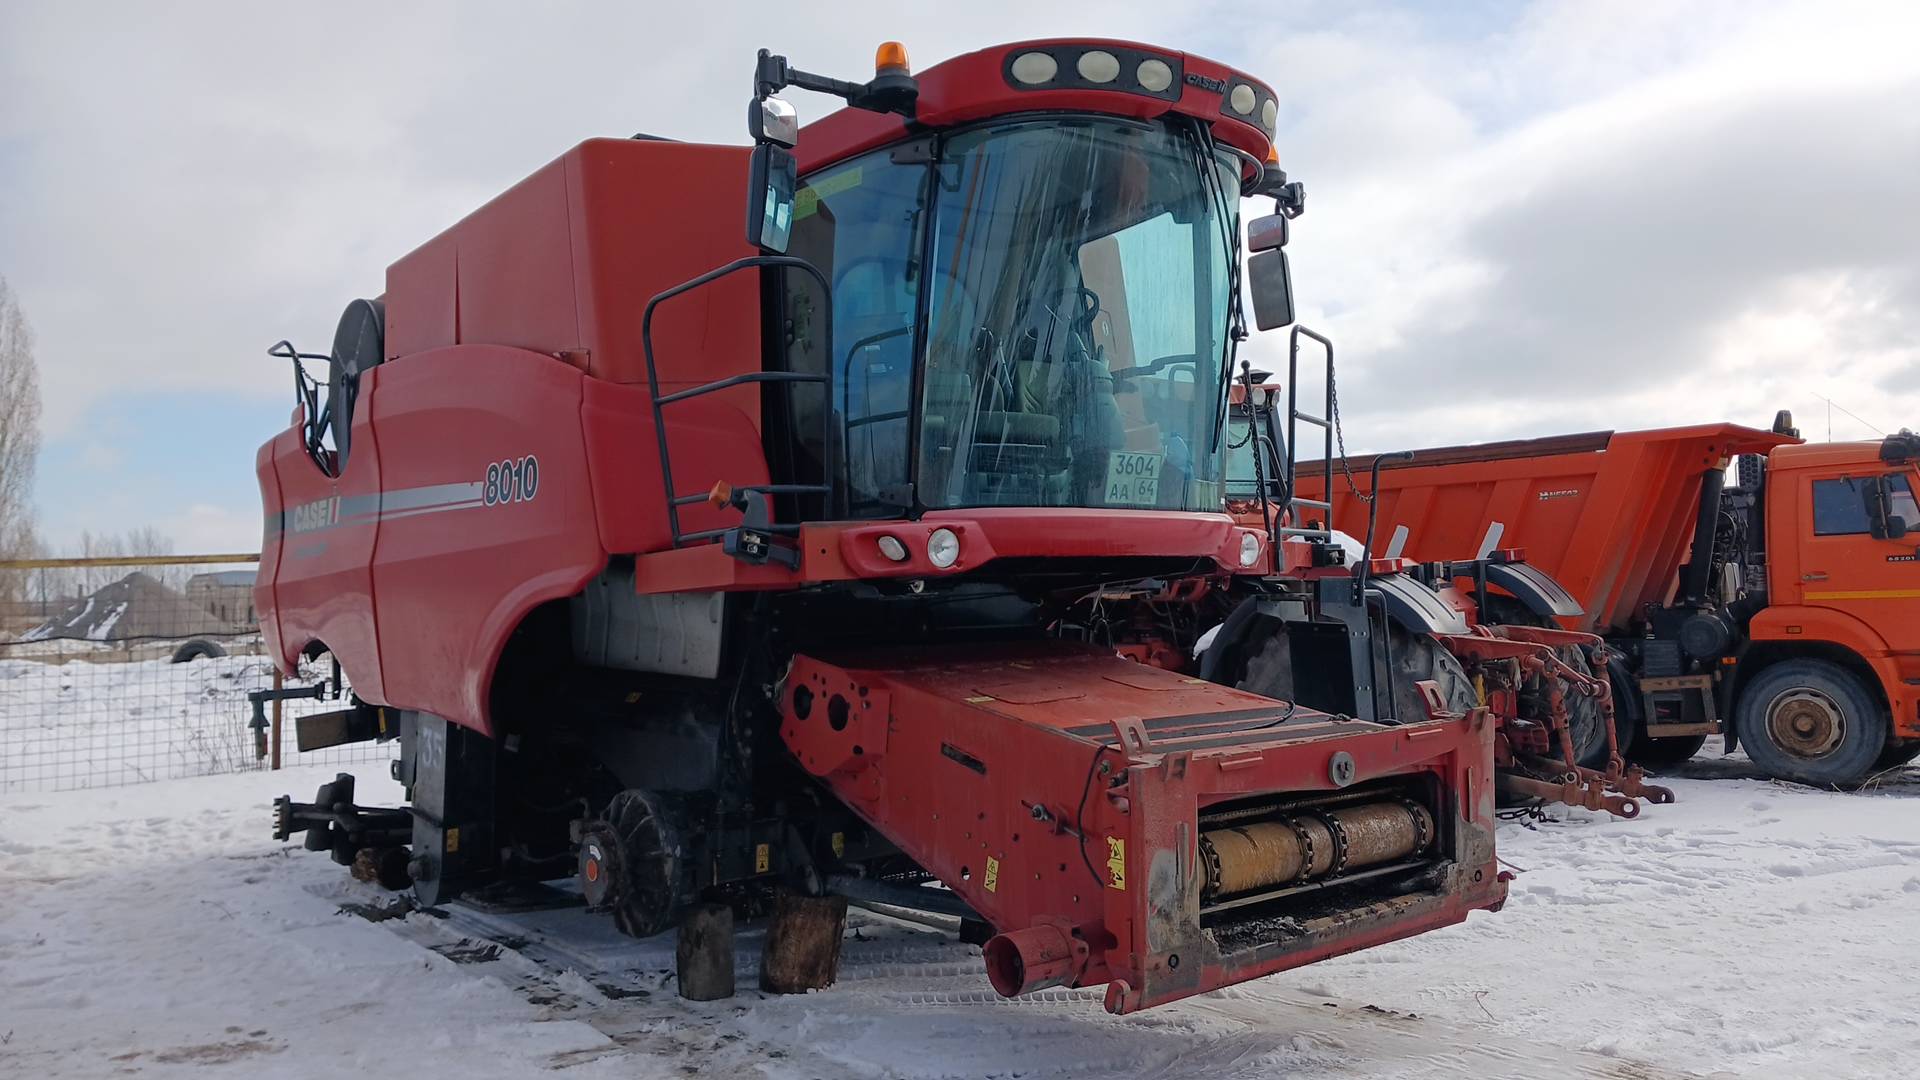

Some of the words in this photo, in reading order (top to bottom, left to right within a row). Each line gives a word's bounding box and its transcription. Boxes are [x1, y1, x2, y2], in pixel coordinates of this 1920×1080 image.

[1115, 455, 1154, 476] 3604
[485, 455, 538, 506] 8010
[1110, 484, 1129, 500] AA
[1139, 481, 1154, 496] 64
